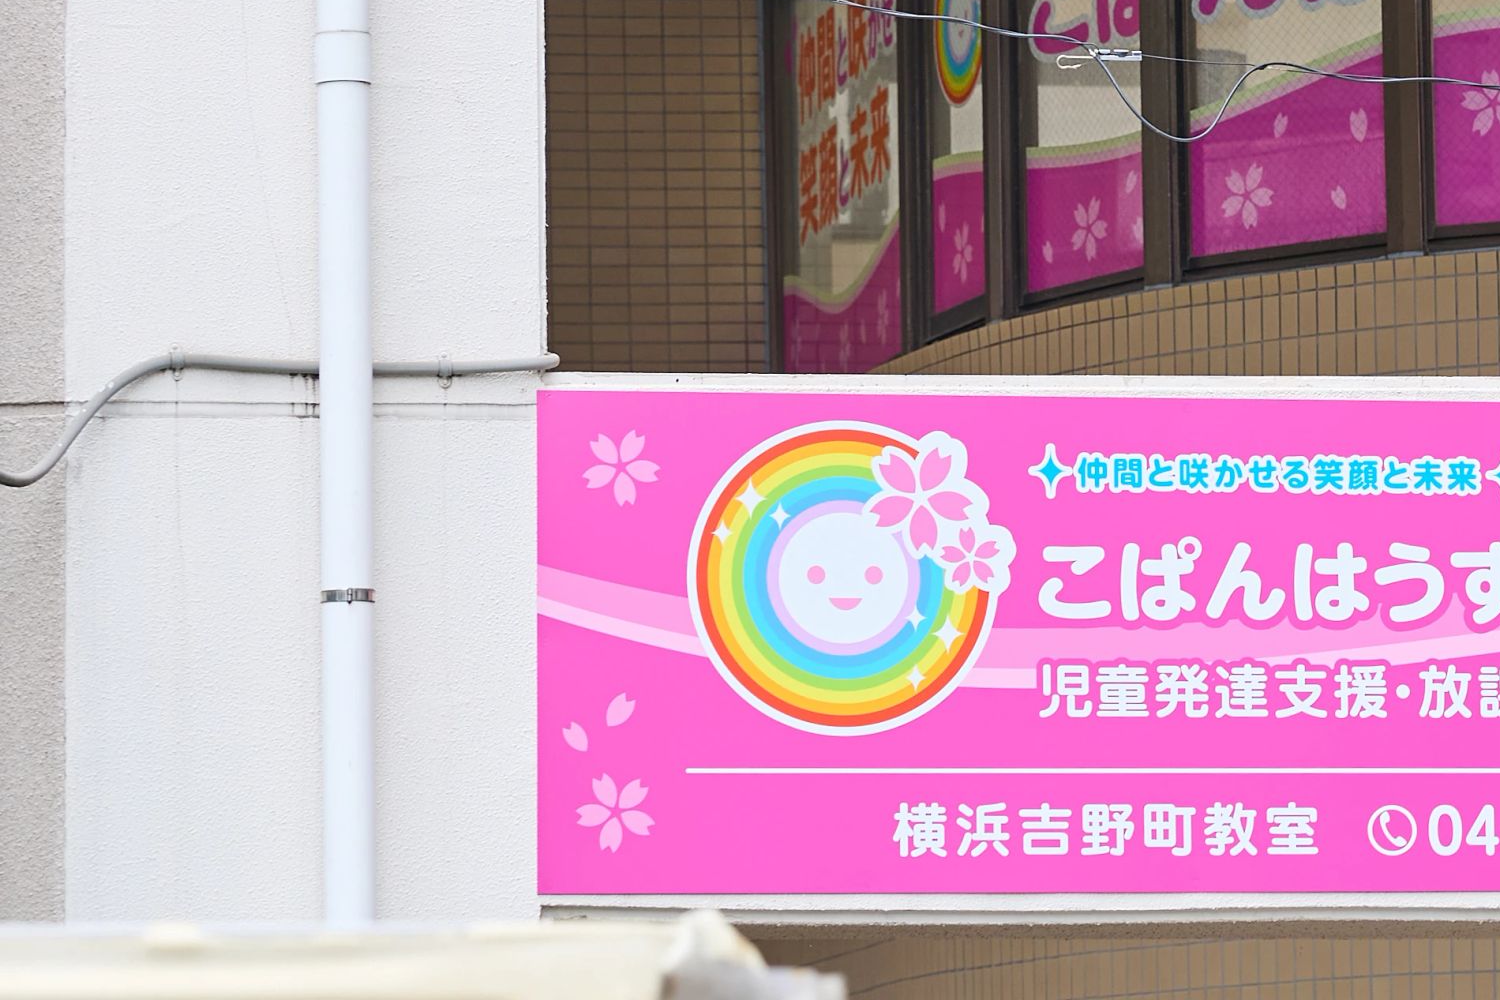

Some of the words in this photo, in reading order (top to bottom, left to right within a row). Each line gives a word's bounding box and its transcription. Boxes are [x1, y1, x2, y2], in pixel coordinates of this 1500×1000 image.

[798, 85, 892, 246] 笑顔と未来
[1076, 455, 1482, 493] 仲間と咲かせる笑顔と未来
[893, 801, 1320, 858] 横浜吉野町教室
